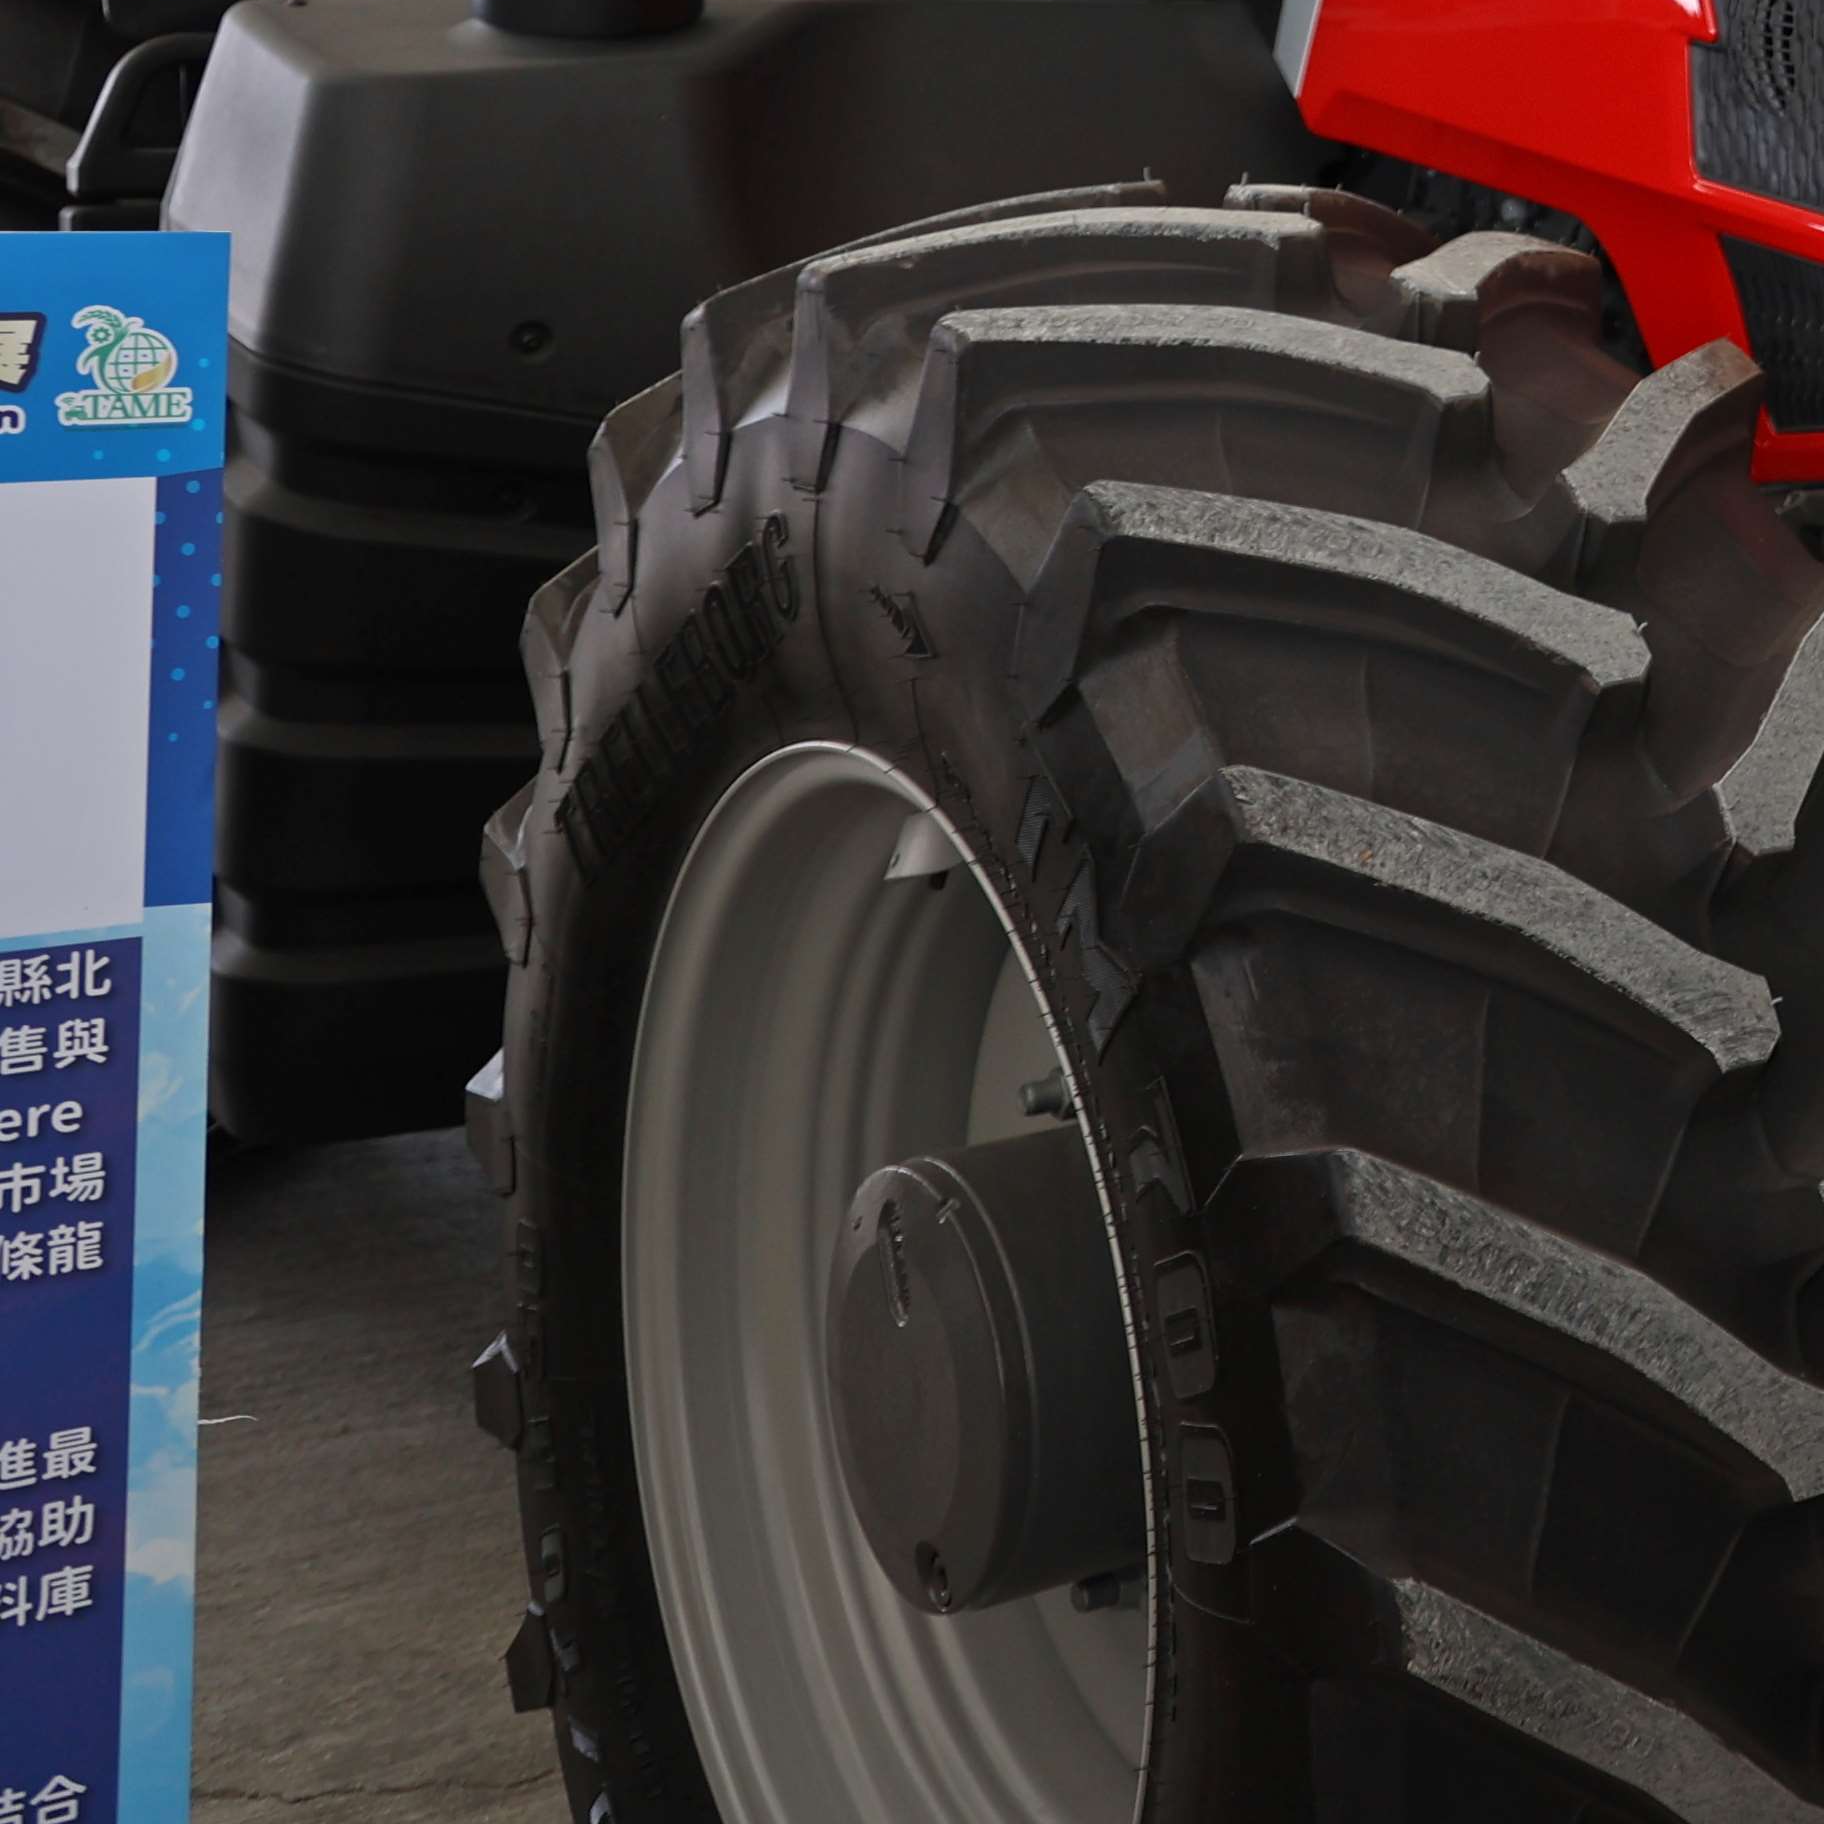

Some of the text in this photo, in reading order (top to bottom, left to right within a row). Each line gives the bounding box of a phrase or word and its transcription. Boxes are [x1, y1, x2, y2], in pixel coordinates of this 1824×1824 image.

[81, 391, 188, 420] TAME
[0, 948, 112, 1008] 縣北
[0, 1018, 110, 1076] 售與
[0, 1151, 107, 1214] 市場
